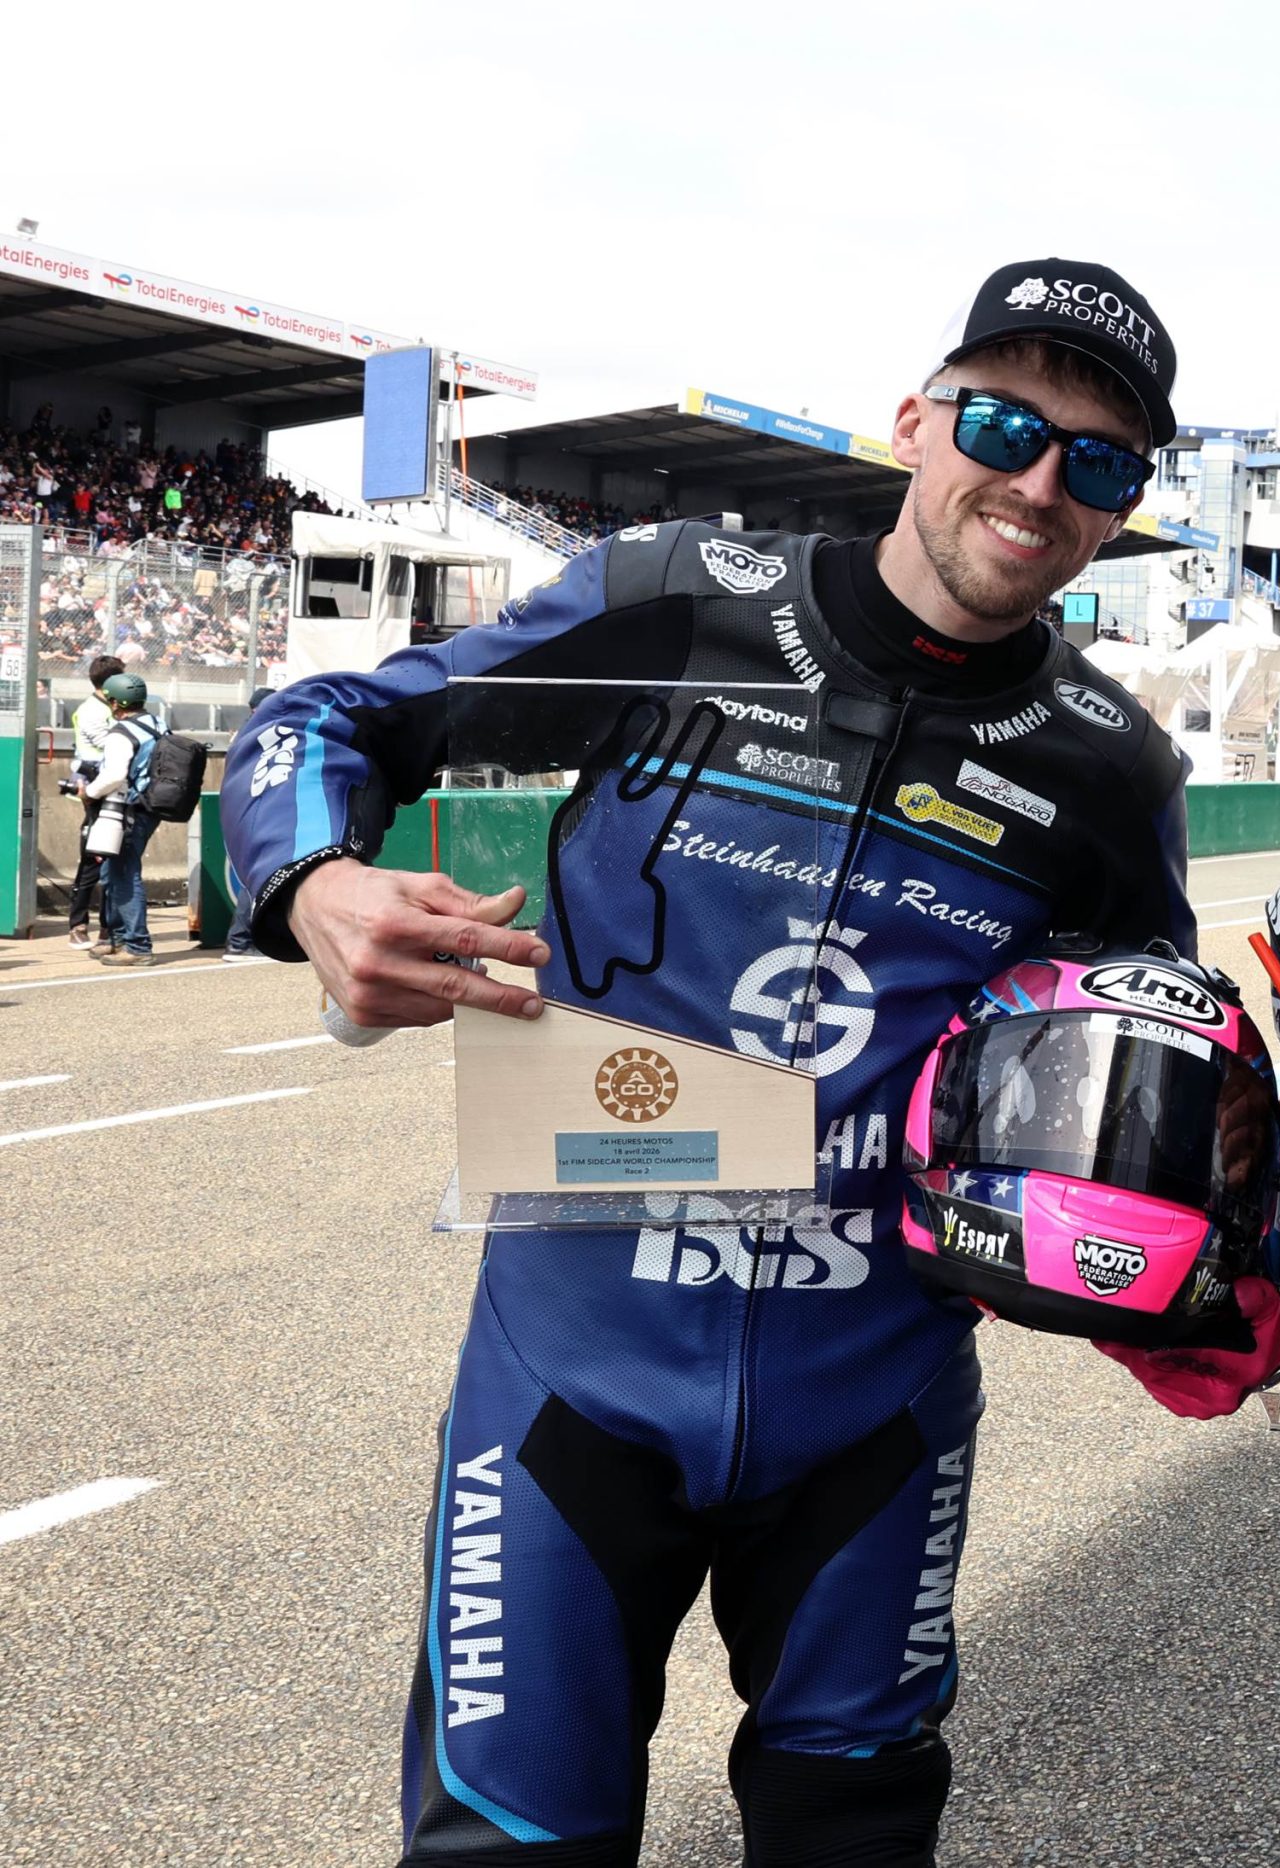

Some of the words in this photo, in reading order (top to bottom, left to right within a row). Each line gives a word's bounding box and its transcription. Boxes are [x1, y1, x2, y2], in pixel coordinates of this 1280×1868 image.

[0, 245, 89, 280] talEnergies
[136, 279, 226, 314] TotalEnergies
[1049, 279, 1155, 347] SCOTT
[262, 311, 341, 342] TotalEnergies
[1043, 300, 1158, 374] PROPERTIES
[474, 365, 536, 392] TotalEnergies
[713, 404, 749, 420] MICHELIN
[859, 444, 890, 458] MICHELIN
[705, 545, 782, 578] MOTO
[1199, 602, 1215, 618] 37
[770, 603, 826, 694] YAMAHA
[970, 701, 1052, 744] YAMAHA
[1058, 688, 1124, 727] Arai
[982, 787, 1050, 822] NOGARO
[662, 820, 887, 897] Steinhausen
[896, 878, 1014, 950] Racing
[1089, 968, 1212, 1014] Arai
[1133, 1030, 1191, 1051] PROPERTIES
[1134, 1018, 1188, 1041] SCOTT
[600, 1138, 609, 1146] 24
[611, 1138, 642, 1146] HEURES
[643, 1137, 673, 1145] MOTOS
[571, 1158, 585, 1166] FIM
[623, 1157, 652, 1165] WORLD
[654, 1157, 716, 1165] CHAMPIONSHIP
[1075, 1242, 1146, 1275] MOTO
[1078, 1263, 1134, 1283] FÉDÉRATION
[1079, 1271, 1128, 1288] FRANÇAISE
[1203, 1277, 1230, 1301] ESP
[898, 1442, 967, 1685] YAMAHA
[448, 1445, 504, 1728] YAMAHA
